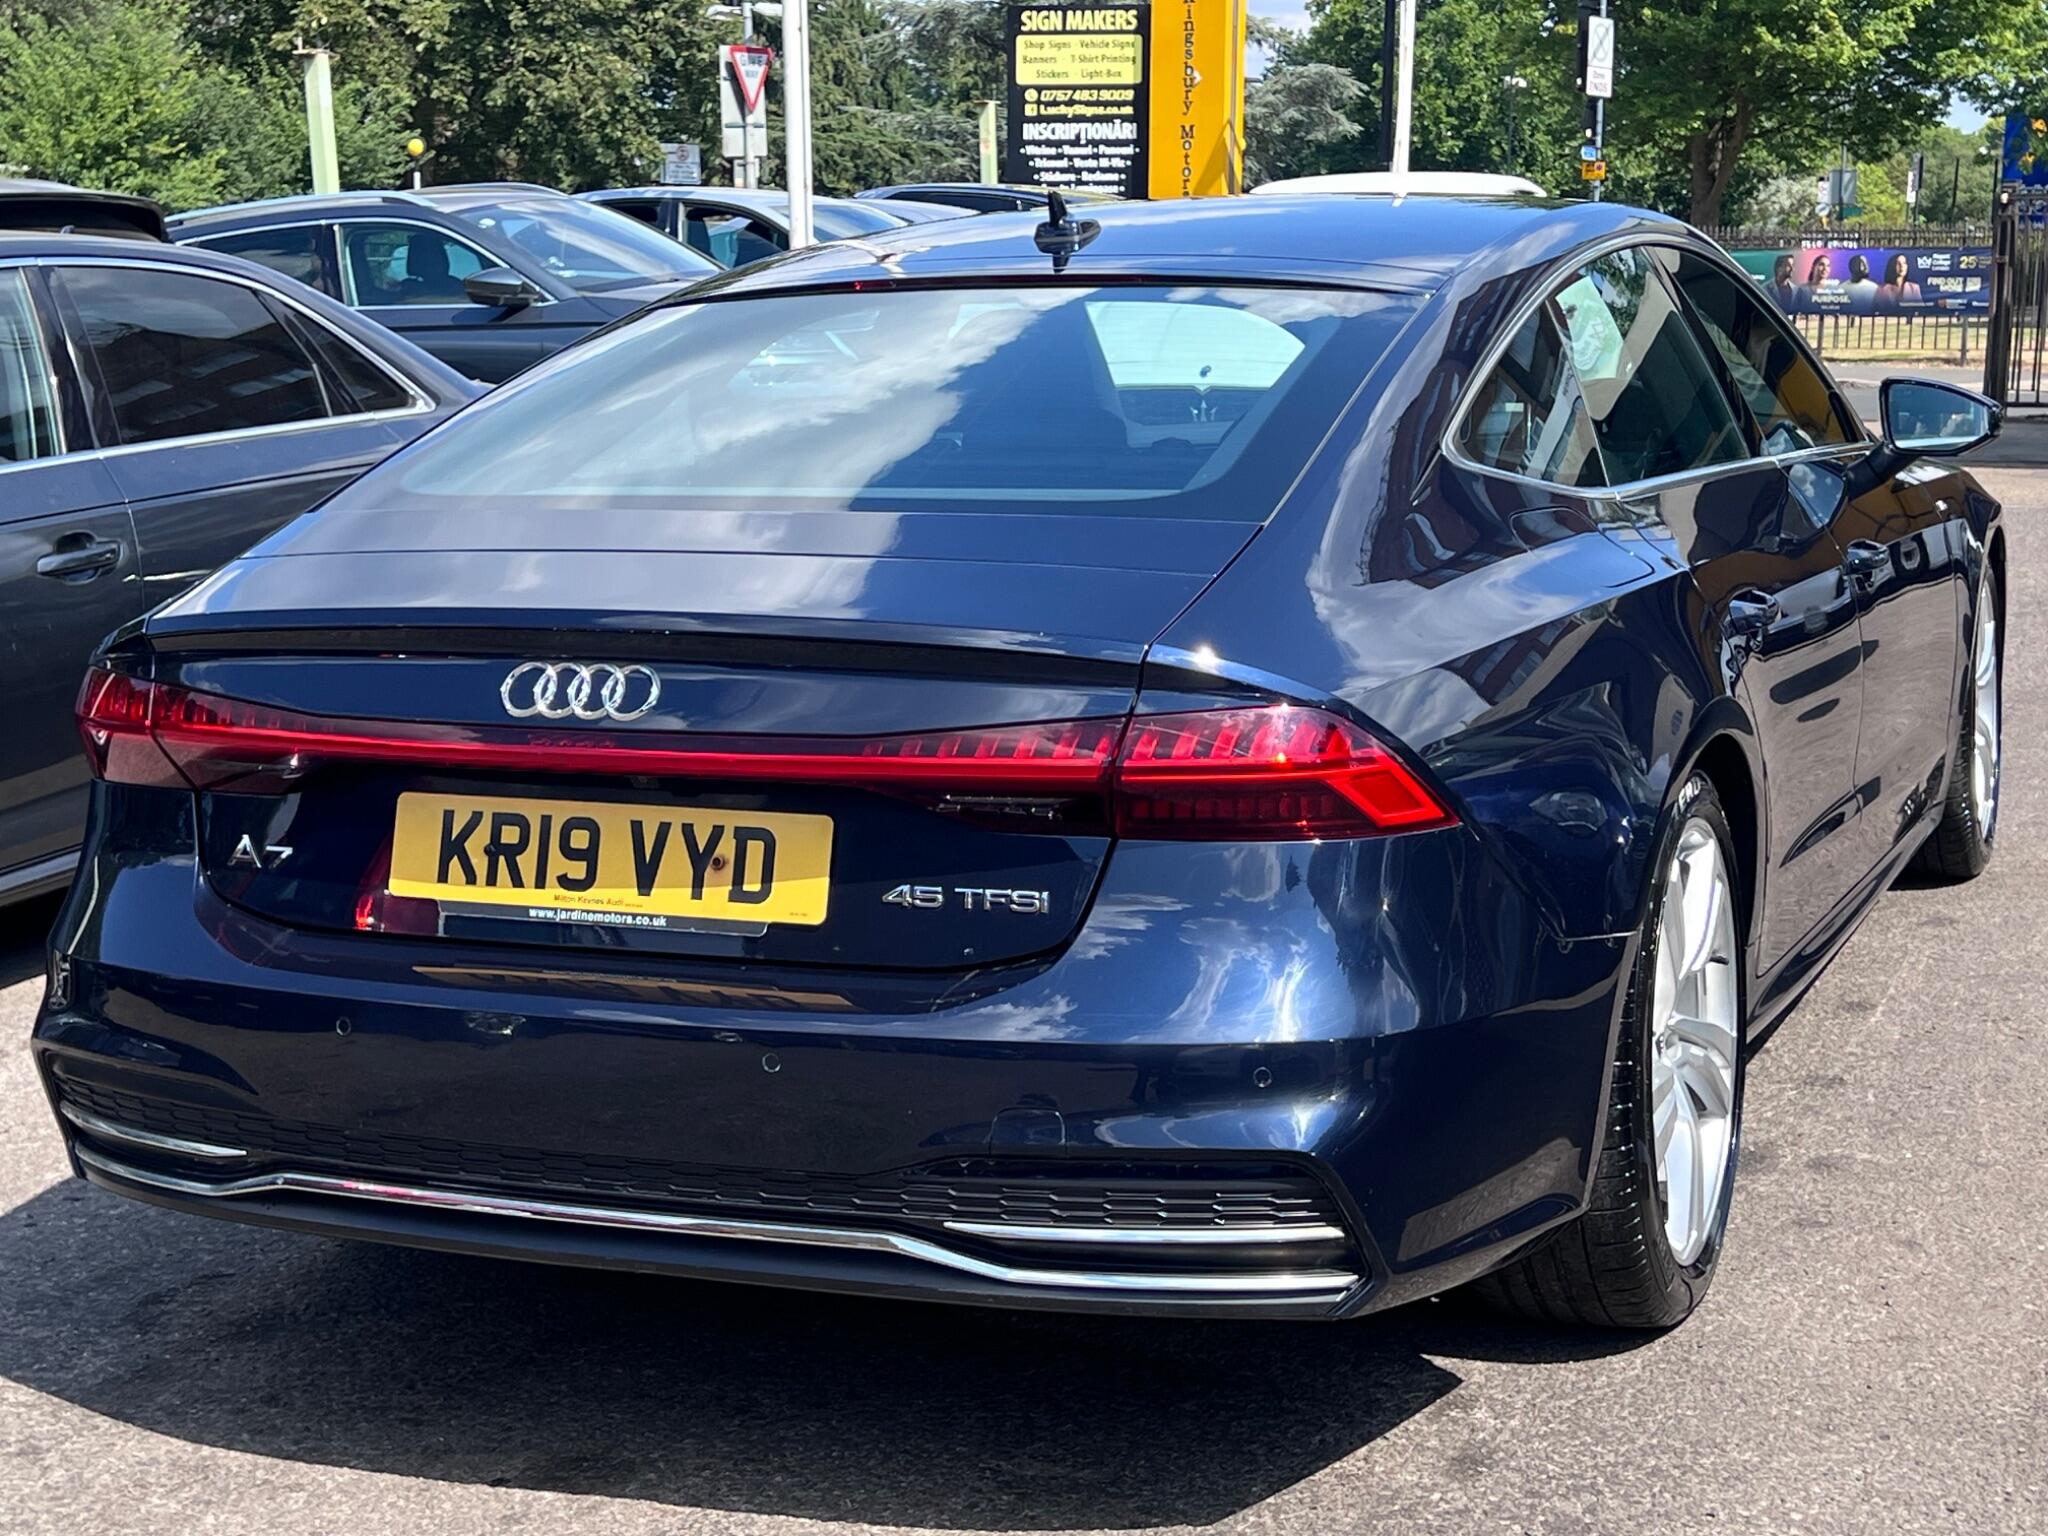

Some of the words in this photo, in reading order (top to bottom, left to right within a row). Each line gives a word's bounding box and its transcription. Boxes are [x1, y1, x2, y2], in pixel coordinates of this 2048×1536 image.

[1020, 10, 1063, 31] SIGN
[1065, 9, 1138, 31] MAKERS
[1024, 39, 1045, 50] Shop
[1048, 39, 1072, 50] Signs
[1078, 39, 1110, 48] Vehicle
[1022, 55, 1057, 64] Banners
[1101, 54, 1137, 65] Printing
[1182, 0, 1196, 116] ingsbury
[1036, 69, 1069, 79] Stickers
[1959, 255, 1977, 269] 25
[227, 834, 294, 869] A7
[436, 808, 601, 892] KR19
[630, 819, 777, 905] VYD
[882, 884, 944, 909] 45
[954, 887, 1050, 914] TFSI
[528, 907, 667, 926] www.jardinemotors.co.uk
